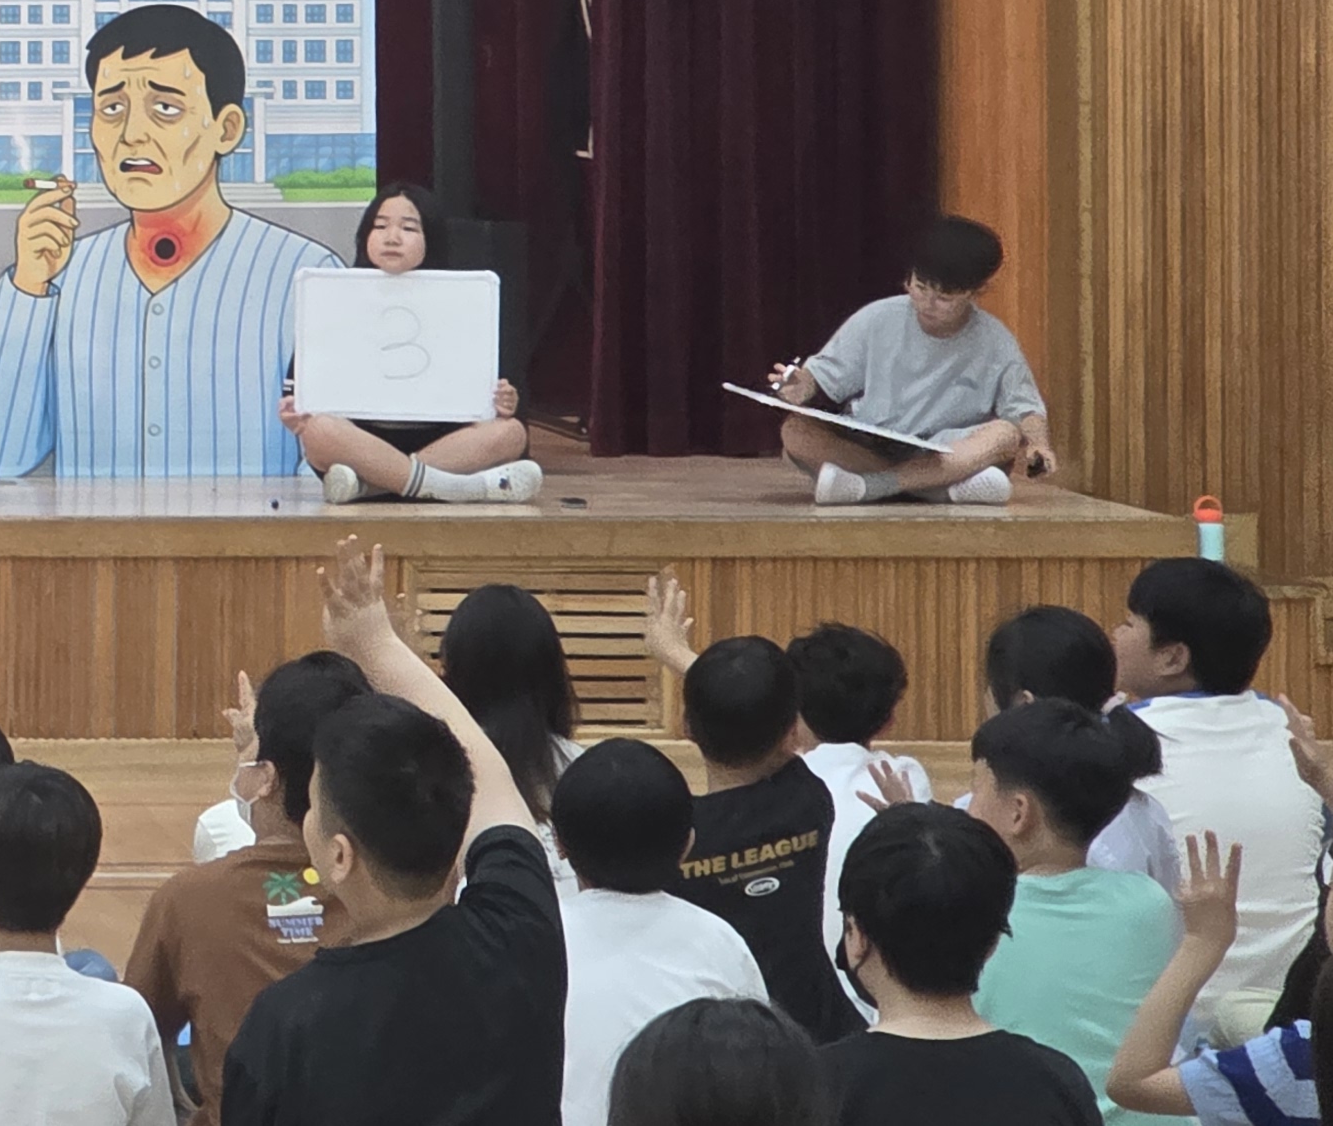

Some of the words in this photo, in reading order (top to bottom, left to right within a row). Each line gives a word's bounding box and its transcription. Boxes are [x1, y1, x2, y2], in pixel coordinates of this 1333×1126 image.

[381, 306, 431, 380] 3
[679, 855, 727, 880] THE
[731, 830, 819, 869] LEAGUE
